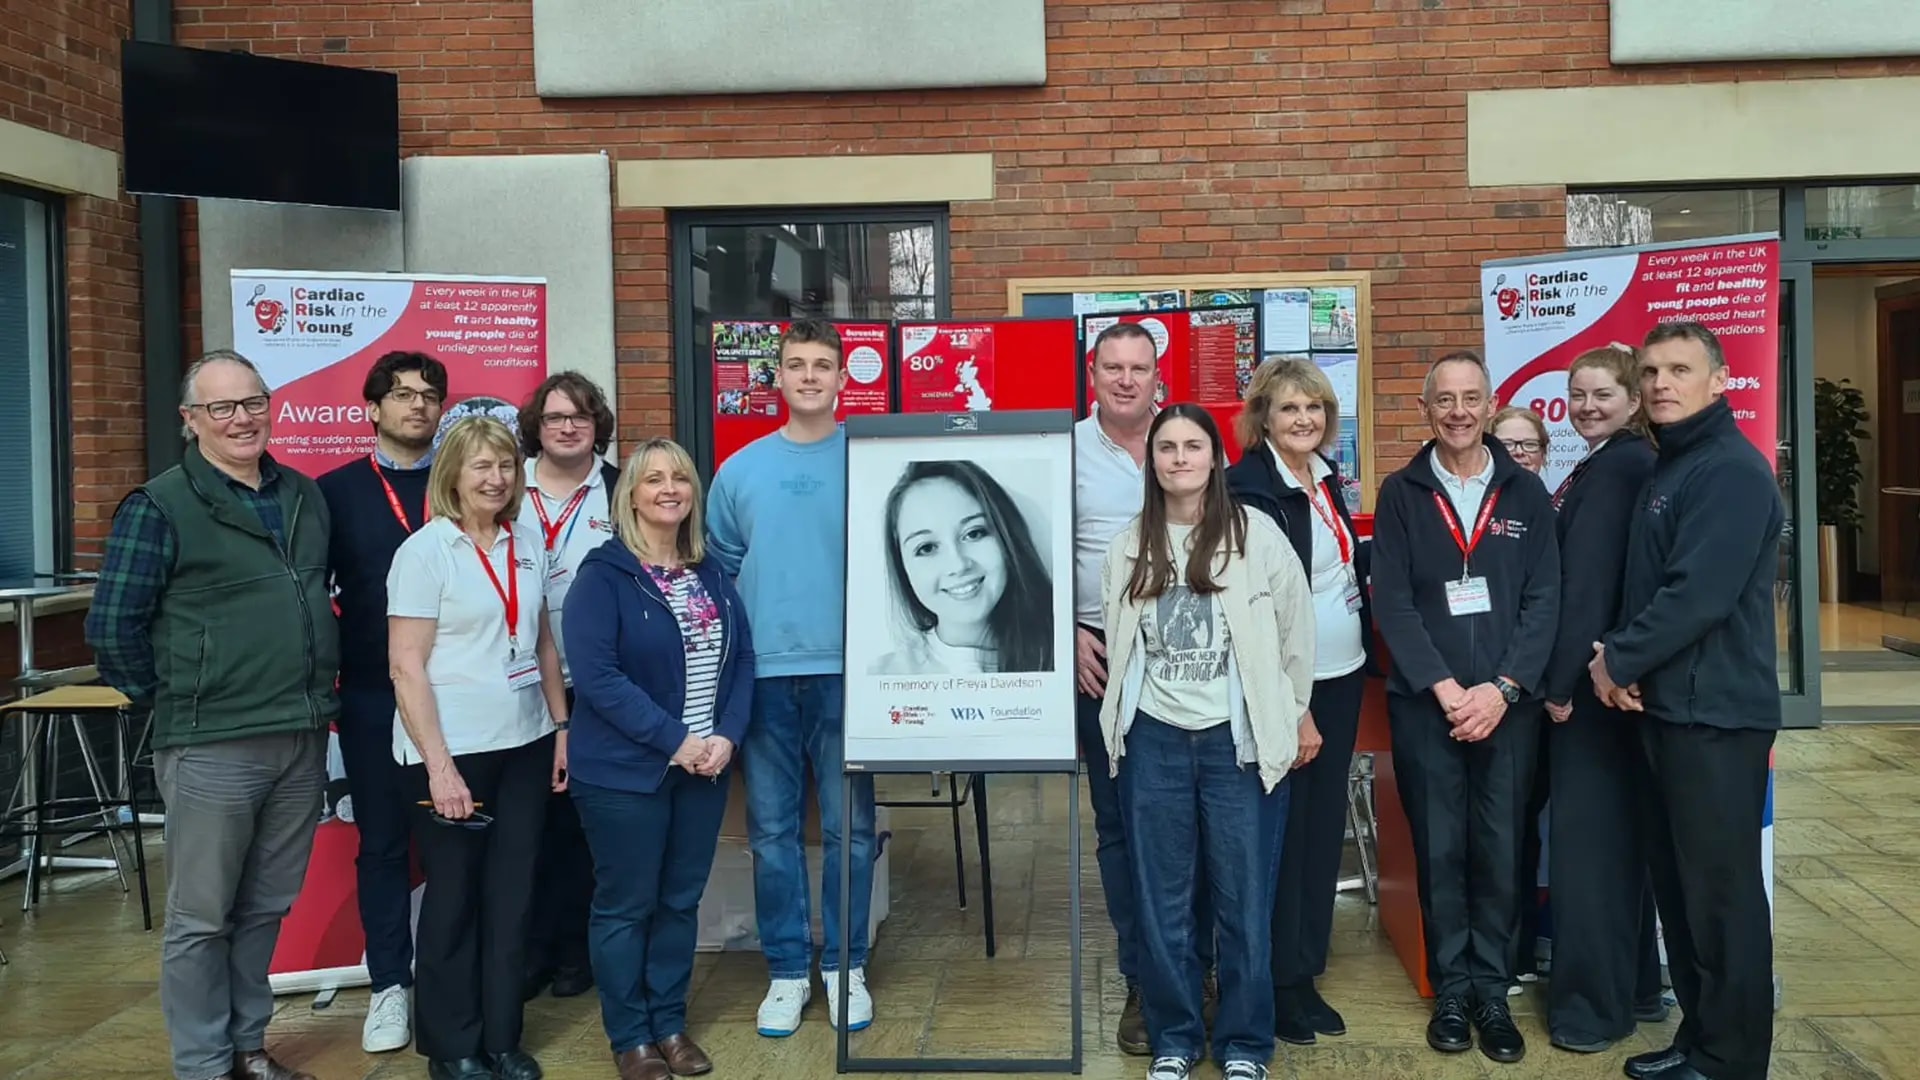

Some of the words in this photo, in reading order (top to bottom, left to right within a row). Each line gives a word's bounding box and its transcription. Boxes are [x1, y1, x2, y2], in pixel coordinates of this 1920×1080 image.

[1648, 255, 1678, 266] Every
[1681, 252, 1710, 262] week
[1712, 250, 1723, 260] in
[1727, 248, 1746, 259] the
[1749, 247, 1766, 257] UK
[1529, 270, 1588, 286] Cardiac
[1642, 271, 1653, 281] at
[1656, 269, 1682, 280] least
[1687, 267, 1701, 278] 12
[1704, 263, 1767, 277] apparently
[425, 286, 455, 298] Every
[458, 287, 486, 297] week
[489, 288, 498, 297] in
[501, 288, 519, 298] the
[522, 289, 537, 298] UK
[1530, 287, 1561, 301] Risk
[1565, 285, 1579, 298] in
[1584, 284, 1608, 297] the
[1676, 282, 1690, 293] fit
[1692, 281, 1715, 291] and
[1717, 278, 1767, 290] healthy
[294, 287, 365, 301] Cardiac
[420, 301, 431, 310] at
[434, 300, 461, 310] least
[463, 301, 478, 311] 12
[480, 302, 538, 314] apparently
[1647, 298, 1683, 312] young
[1686, 295, 1729, 309] people
[1732, 294, 1750, 304] die
[1754, 292, 1766, 303] of
[295, 303, 336, 317] Risk
[341, 304, 355, 317] in
[361, 304, 387, 317] the
[1530, 302, 1576, 317] Young
[1658, 310, 1730, 323] undiagnosed
[1733, 309, 1766, 320] heart
[454, 315, 468, 324] fit
[470, 316, 491, 325] and
[494, 316, 538, 327] healthy
[296, 320, 353, 337] Young
[425, 329, 462, 340] young
[464, 330, 505, 340] people
[508, 330, 525, 339] die
[527, 330, 538, 339] of
[1708, 324, 1766, 336] onditions
[950, 333, 968, 346] 12
[437, 343, 507, 354] undiagnosed
[509, 344, 538, 353] heart
[484, 357, 538, 367] conditions
[910, 355, 944, 371] 80%
[1529, 397, 1567, 423] 80
[268, 435, 310, 446] venting
[312, 435, 352, 445] sudden
[879, 680, 890, 691] In
[893, 680, 939, 693] memory
[943, 678, 953, 691] of
[956, 678, 987, 692] Freya
[990, 676, 1042, 690] Davidson
[950, 707, 985, 721] WPA
[990, 705, 1043, 717] Foundation
